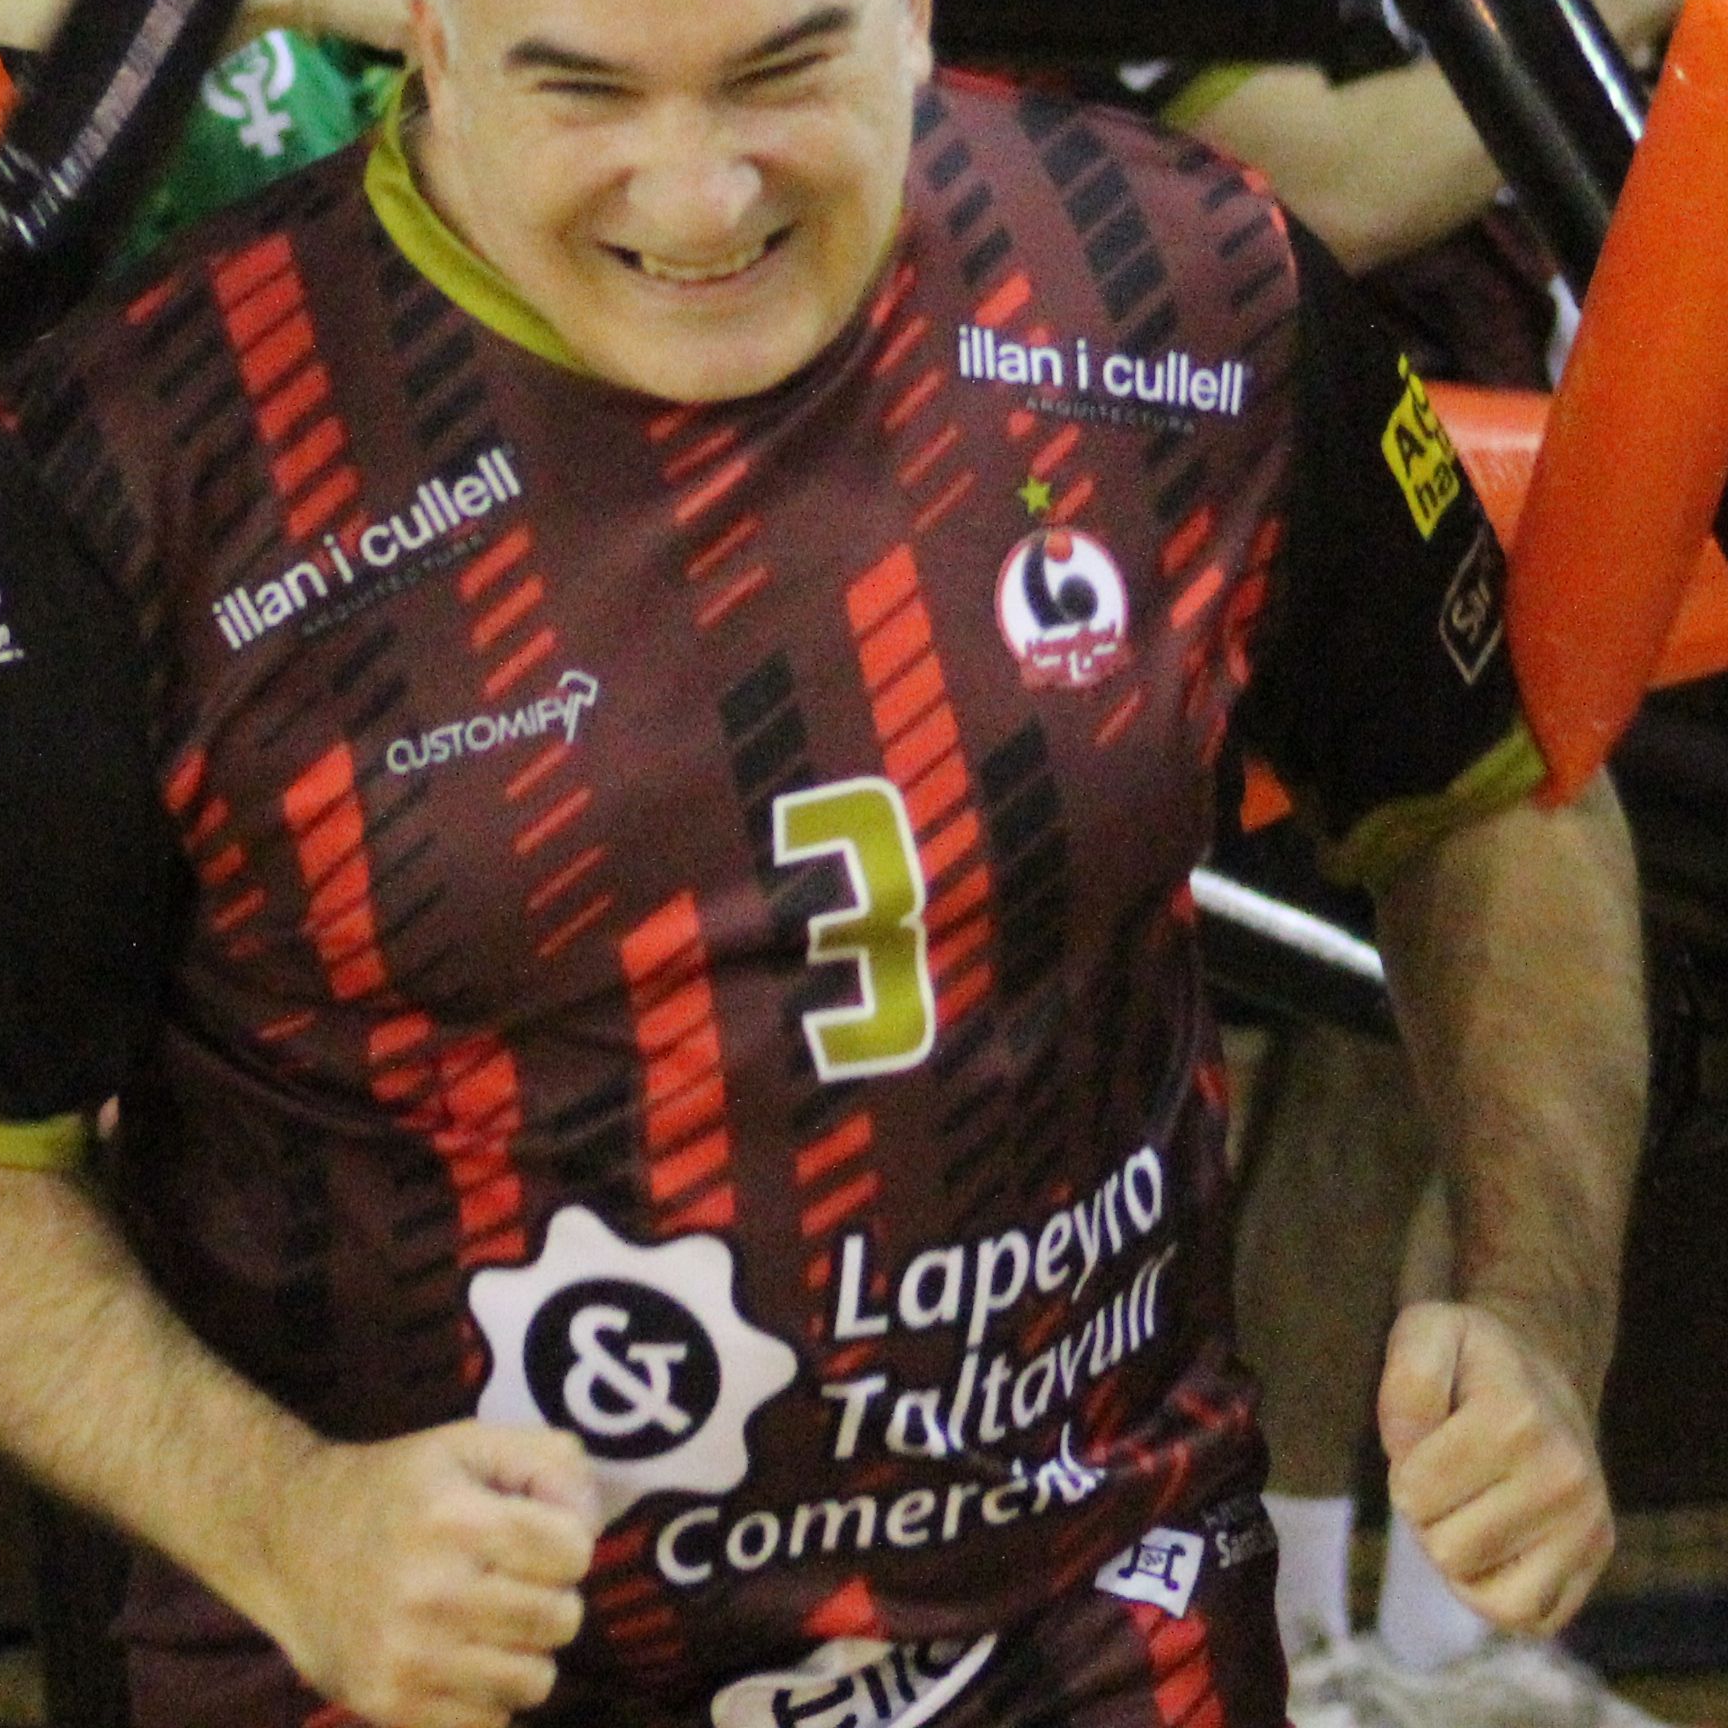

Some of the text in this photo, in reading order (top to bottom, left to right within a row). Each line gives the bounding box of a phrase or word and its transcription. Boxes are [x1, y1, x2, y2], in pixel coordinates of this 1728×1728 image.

[959, 325, 1243, 416] illan i cullell
[212, 447, 521, 650] illan i cullell
[773, 776, 935, 1083] 3
[833, 1145, 1166, 1345] Lapeyro
[822, 1243, 1178, 1461] Taltavull
